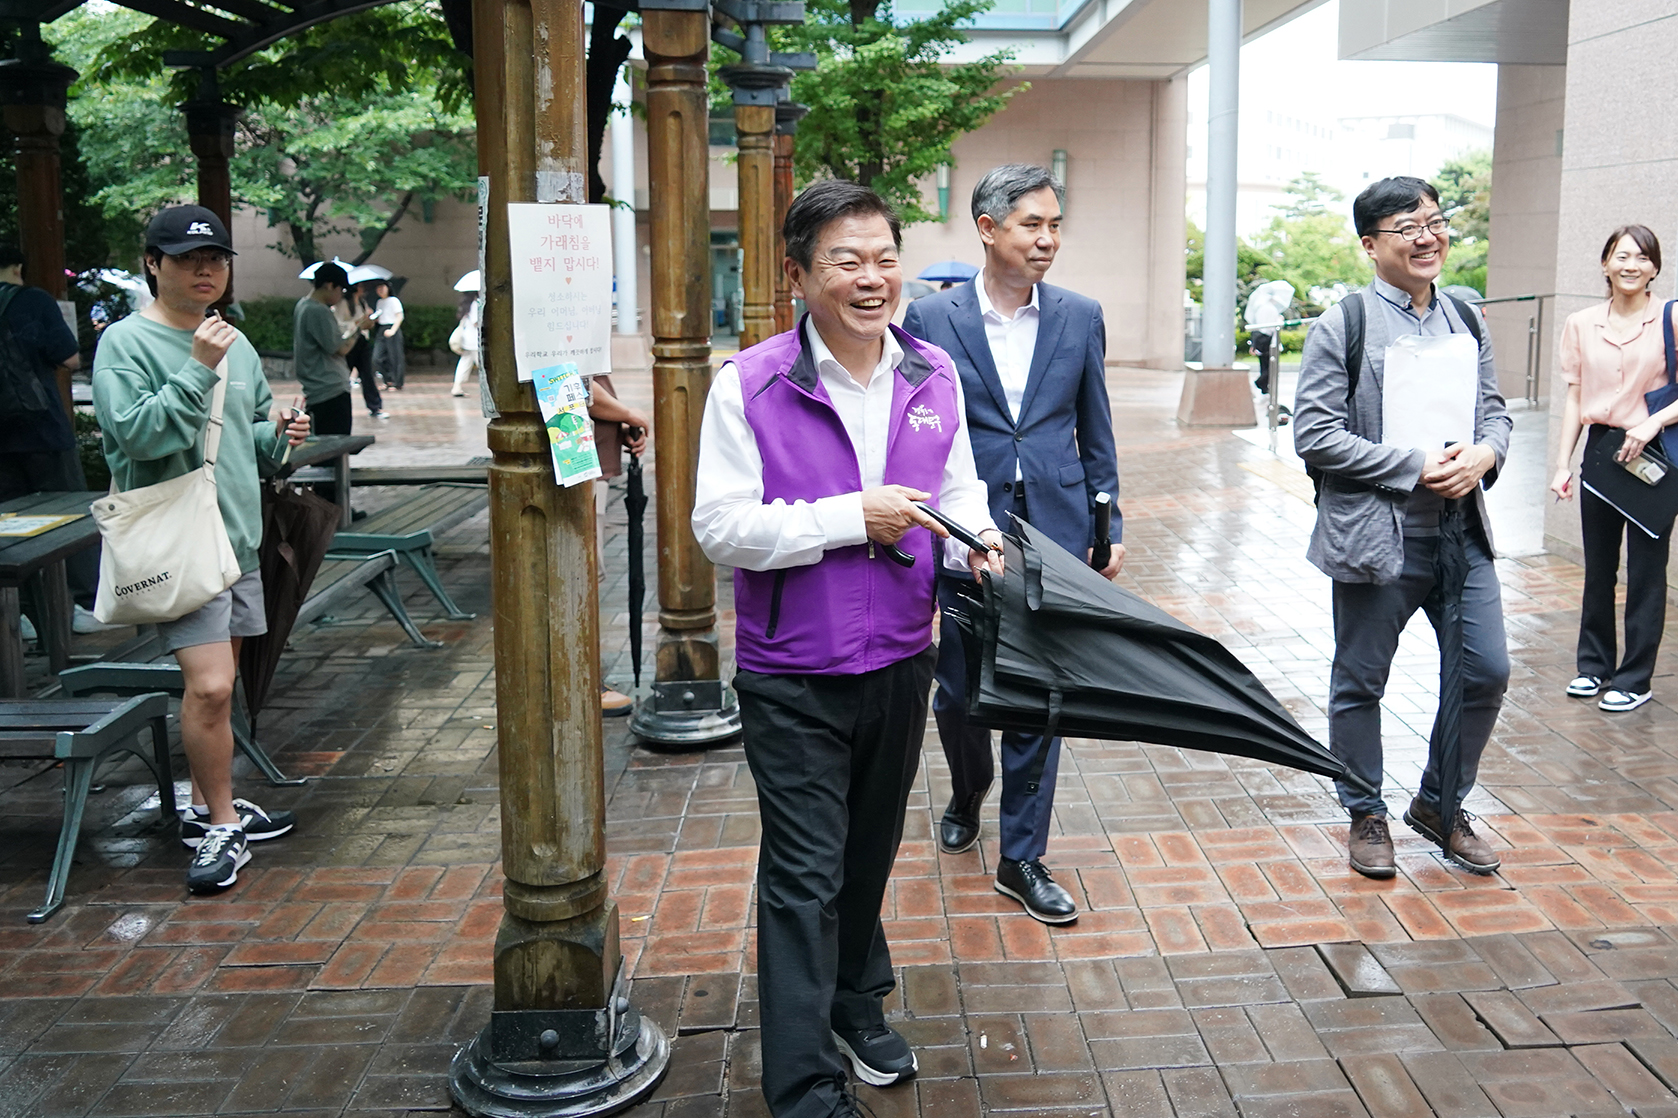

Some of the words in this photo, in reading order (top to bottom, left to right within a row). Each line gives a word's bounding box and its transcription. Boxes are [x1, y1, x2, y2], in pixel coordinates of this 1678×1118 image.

[547, 214, 583, 229] 바닥에
[540, 234, 591, 251] 가래침을
[529, 257, 556, 272] 뱉지
[563, 256, 600, 272] 맙시다!
[528, 307, 546, 318] 우리
